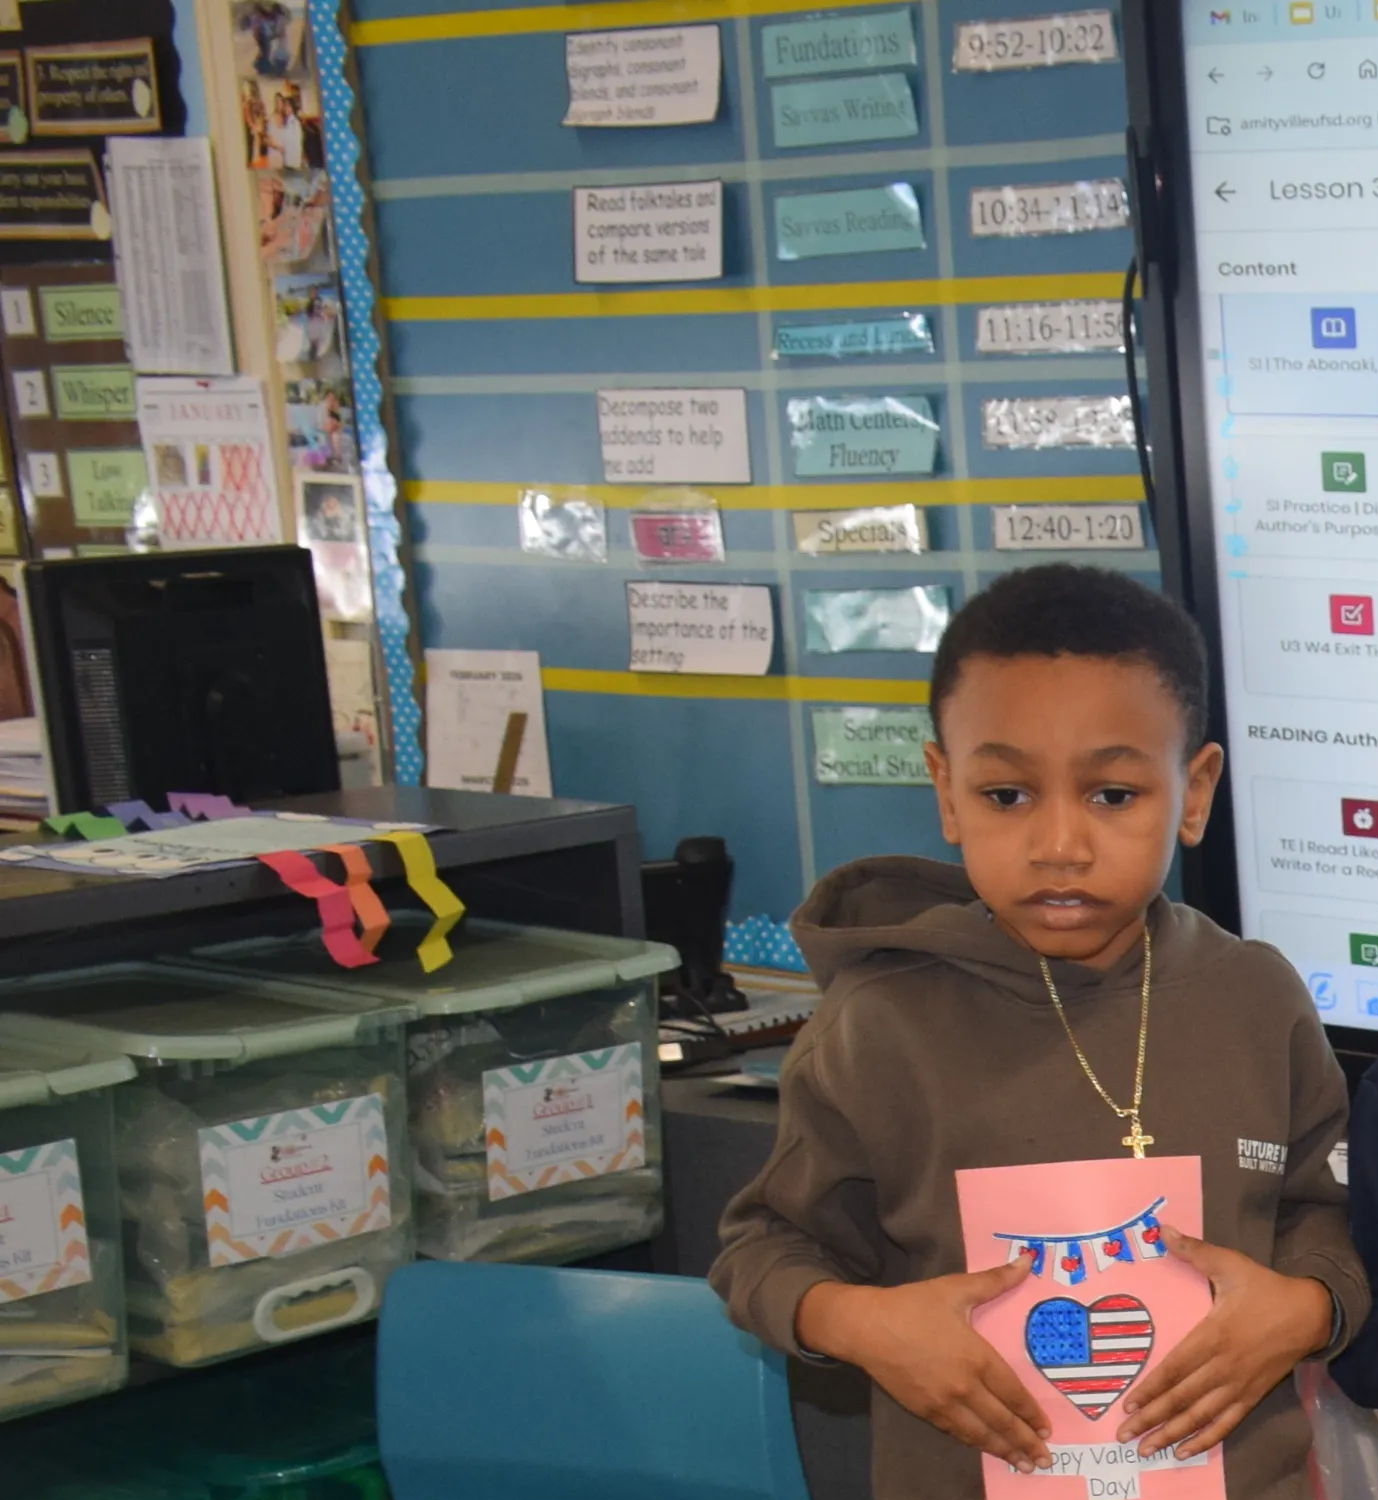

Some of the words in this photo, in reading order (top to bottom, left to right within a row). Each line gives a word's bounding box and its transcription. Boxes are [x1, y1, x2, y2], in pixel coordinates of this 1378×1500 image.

[775, 30, 899, 65] Fundations
[968, 23, 1104, 60] 9:52-10:32
[587, 193, 627, 212] Read
[630, 189, 693, 210] folktales
[1269, 179, 1365, 201] Lesson
[587, 218, 651, 241] compare
[657, 216, 710, 236] versions
[613, 243, 638, 264] the
[642, 247, 678, 262] same
[1218, 261, 1298, 277] Content
[54, 300, 116, 328] Silence
[62, 378, 131, 413] Whisper
[601, 398, 684, 419] Decompose
[690, 399, 719, 416] two
[601, 427, 662, 446] addends
[668, 429, 684, 446] to
[689, 427, 724, 450] help
[627, 457, 655, 476] add
[829, 444, 902, 472] Fluency
[1006, 514, 1134, 542] 12:40-1:20
[630, 590, 698, 611] Describe
[703, 591, 729, 611] the
[632, 621, 715, 646] importance
[719, 623, 738, 641] of
[742, 623, 768, 642] the
[631, 648, 685, 670] setting
[1248, 724, 1328, 744] READING
[1237, 1137, 1281, 1162] FUTURE
